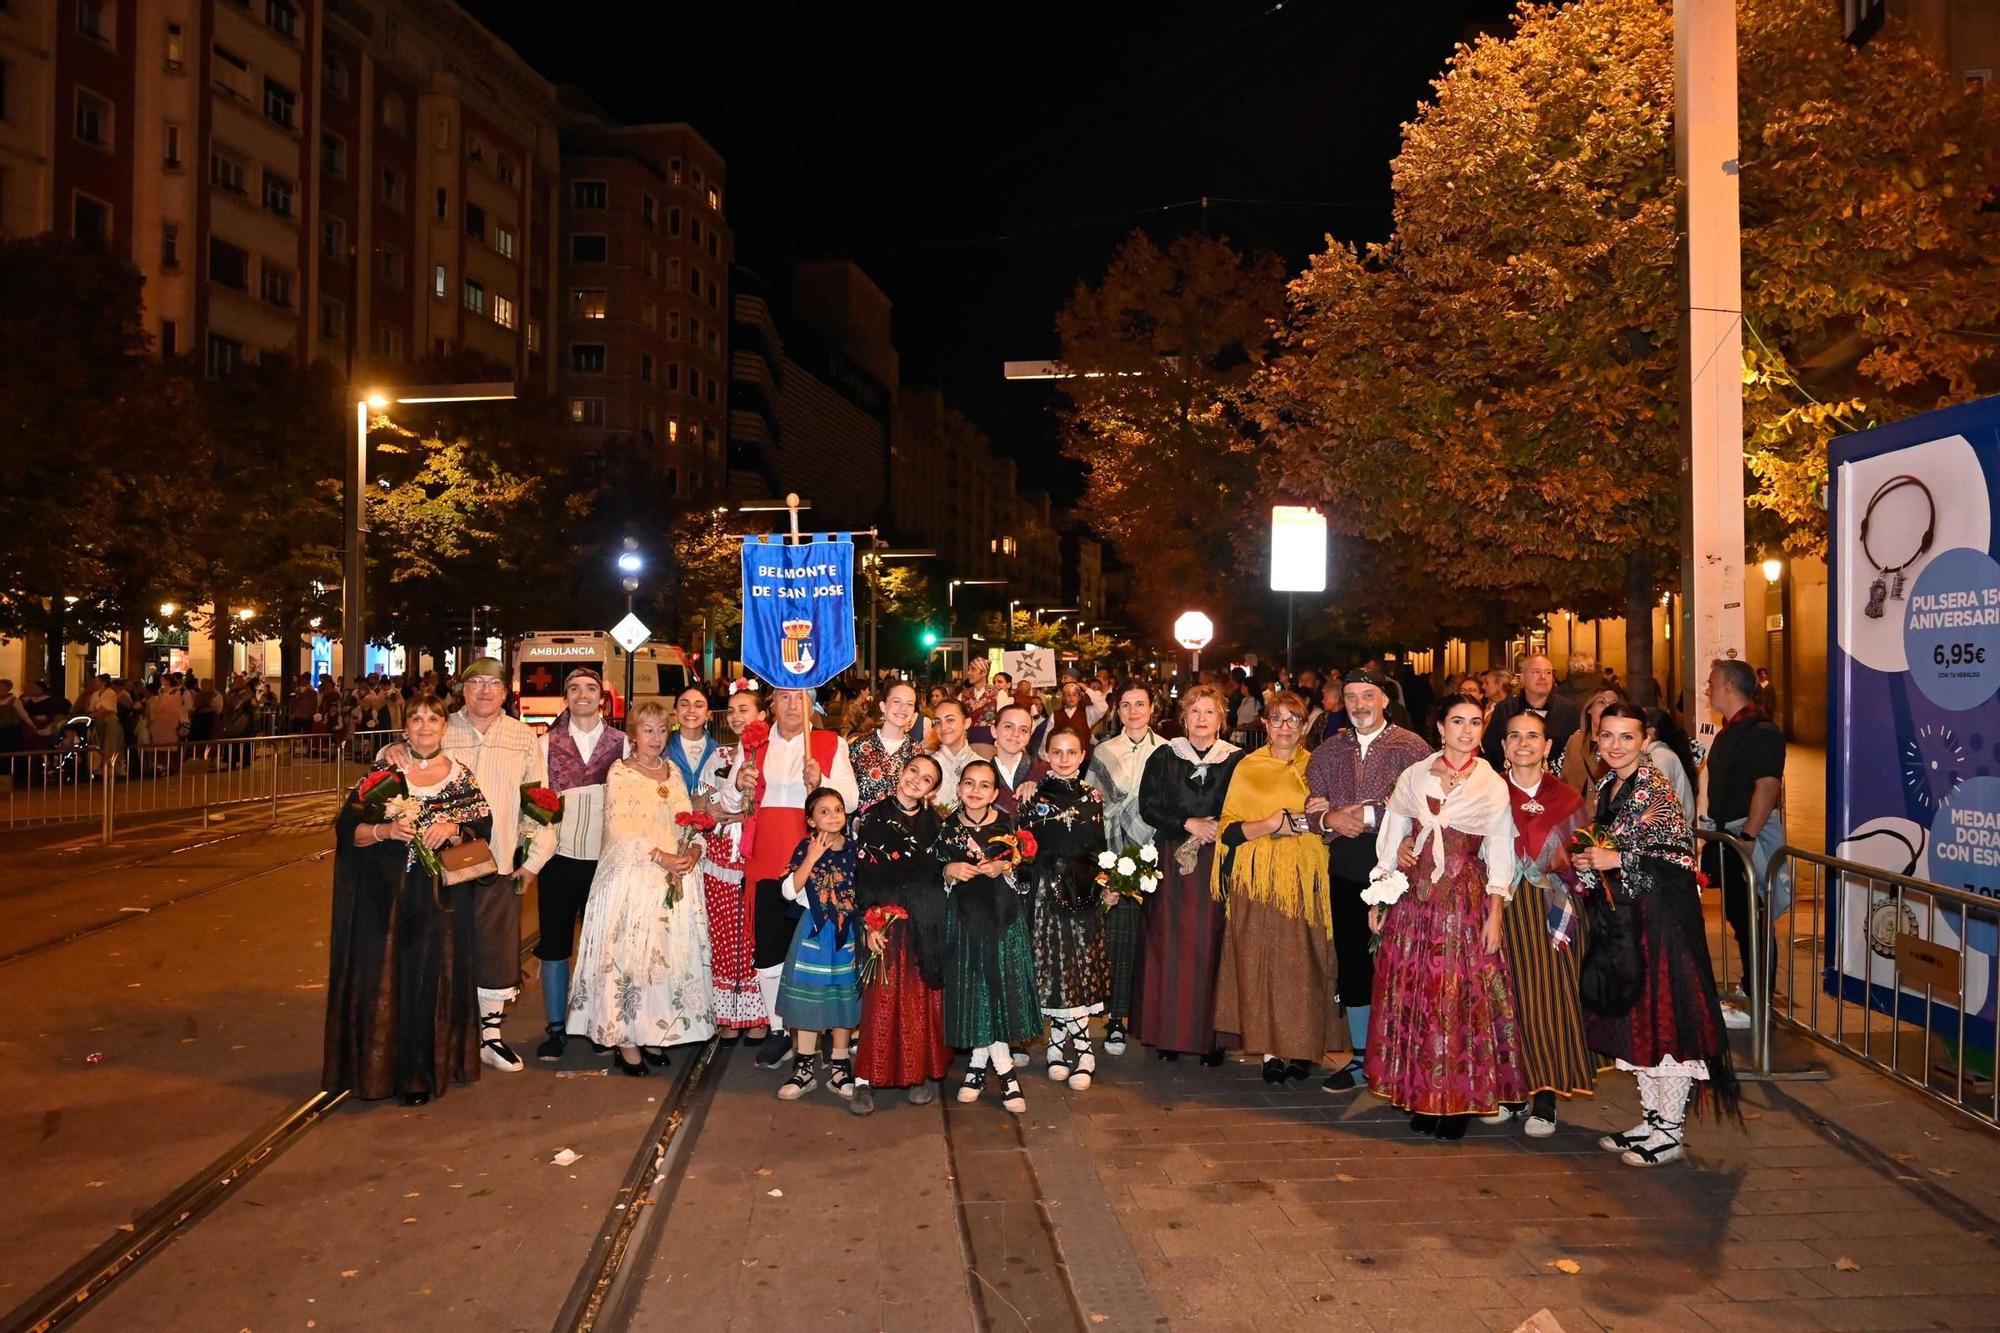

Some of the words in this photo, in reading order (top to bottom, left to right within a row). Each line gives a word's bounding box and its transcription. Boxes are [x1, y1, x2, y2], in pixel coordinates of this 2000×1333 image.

[758, 564, 837, 579] BELMONTE
[752, 585, 771, 597] DE
[778, 586, 806, 598] SAN
[813, 584, 844, 598] JOSE
[1912, 590, 1979, 612] PULSERA
[1909, 608, 2000, 630] ANIVERSARI
[530, 647, 595, 656] AMBULANCIA
[1933, 643, 1986, 669] 6,95€
[1936, 842, 1969, 862] CON
